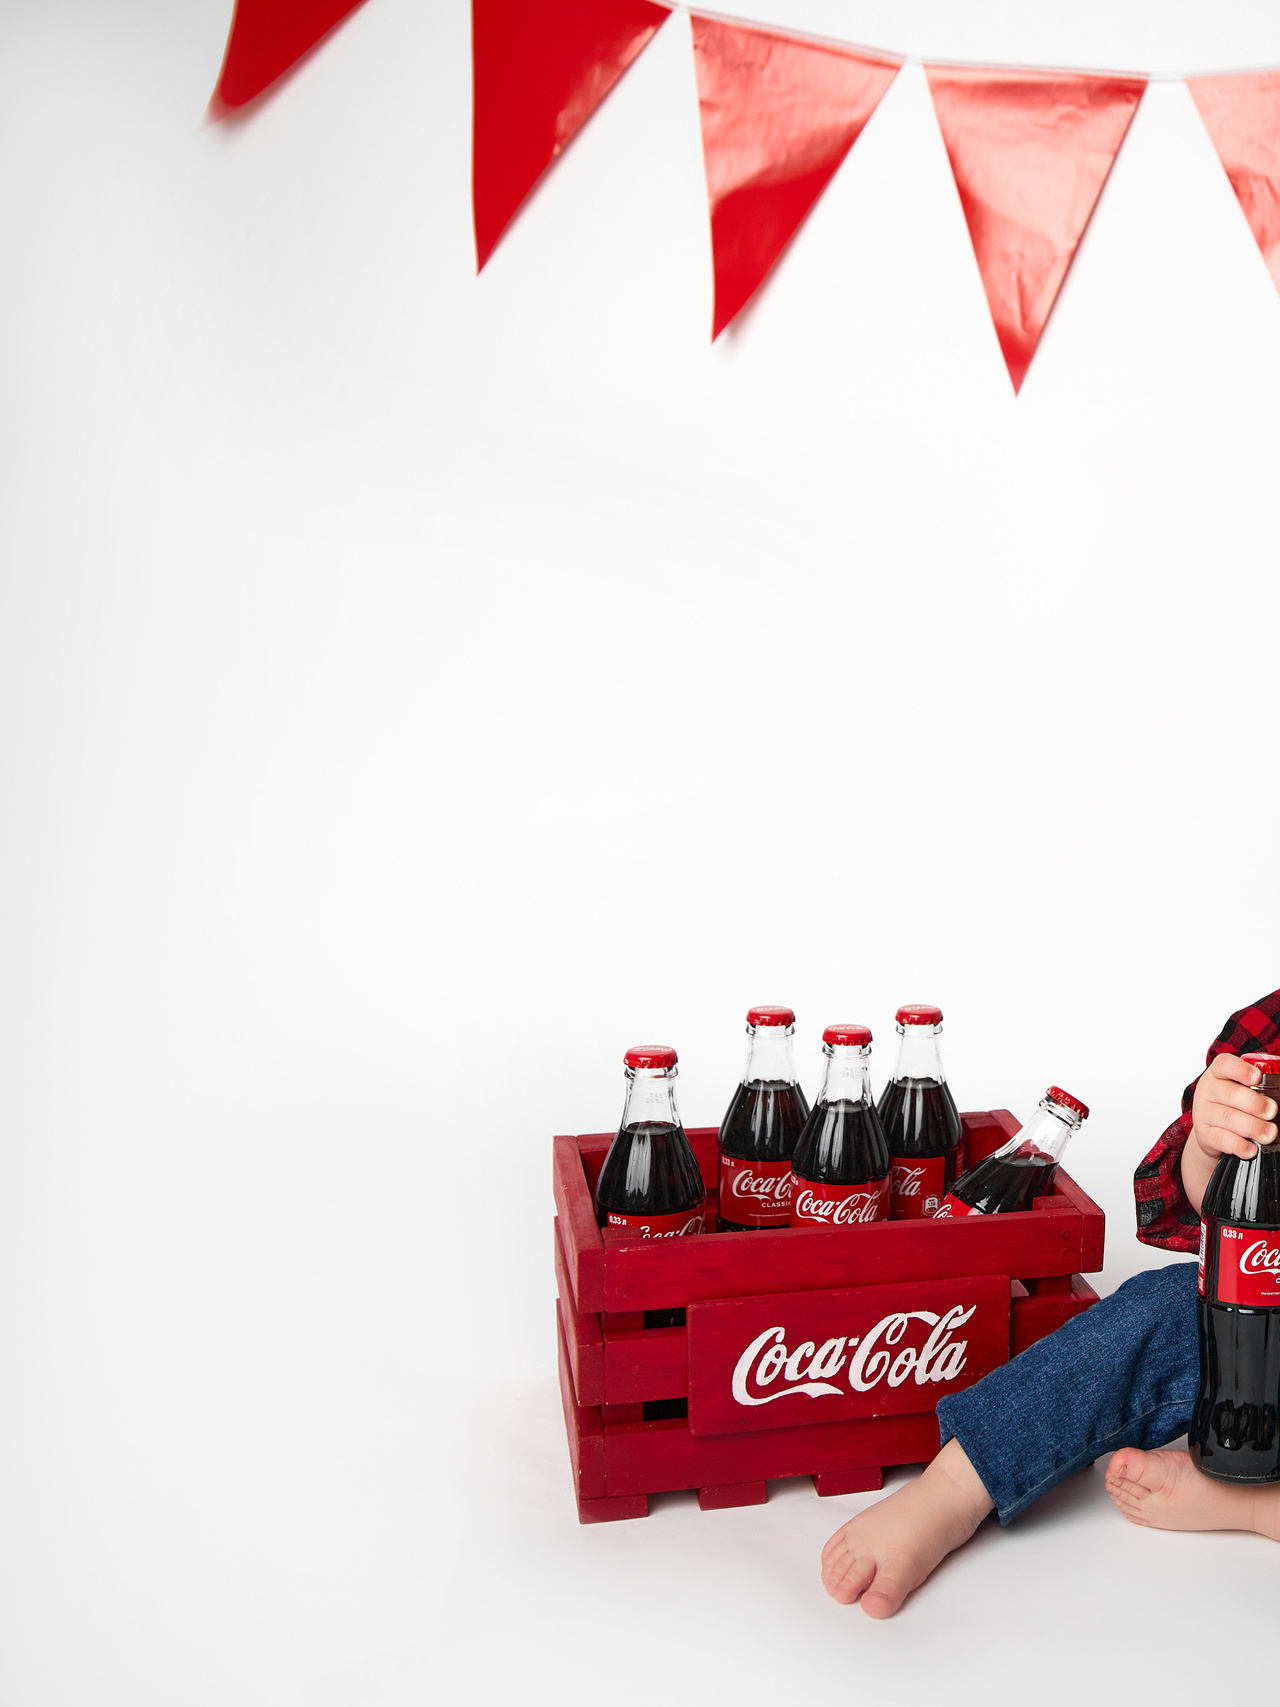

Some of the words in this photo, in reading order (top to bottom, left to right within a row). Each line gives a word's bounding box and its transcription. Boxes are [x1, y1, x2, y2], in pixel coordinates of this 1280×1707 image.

[732, 1169, 791, 1200] Coca-C
[796, 1189, 882, 1224] Coca-Cola
[1222, 1228, 1237, 1239] 0,33
[732, 1304, 977, 1406] Coca-Cola
